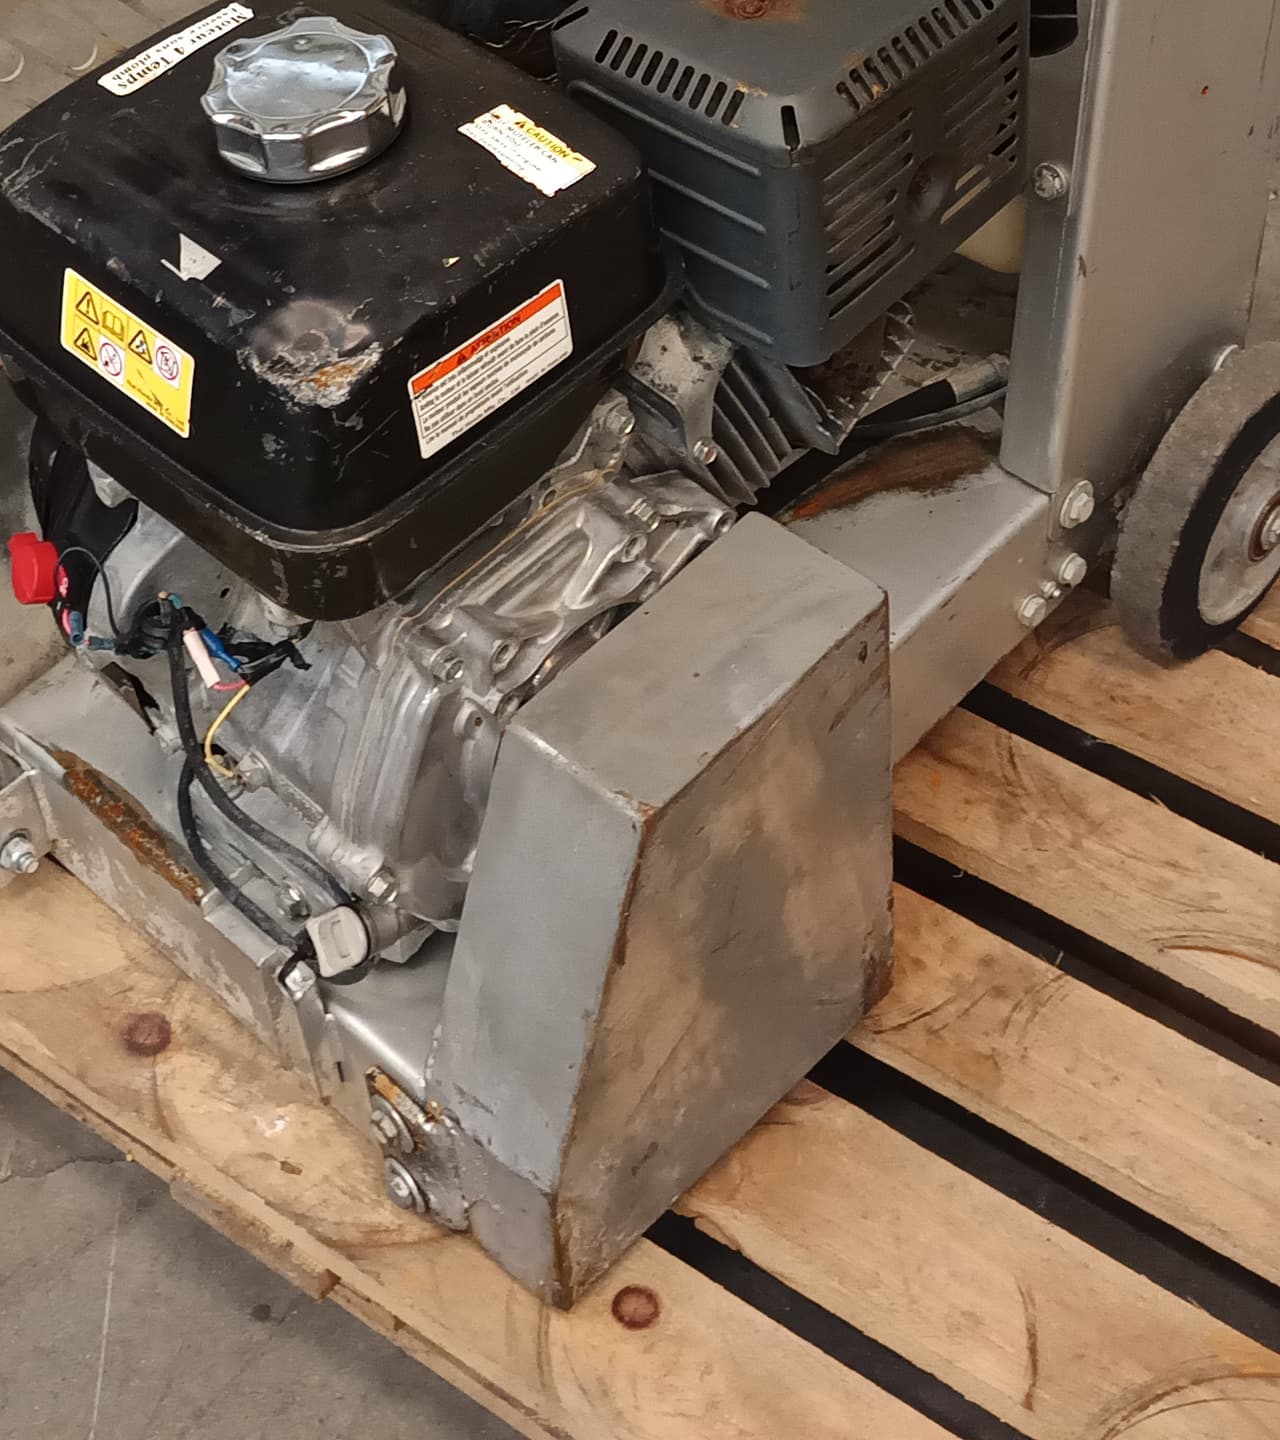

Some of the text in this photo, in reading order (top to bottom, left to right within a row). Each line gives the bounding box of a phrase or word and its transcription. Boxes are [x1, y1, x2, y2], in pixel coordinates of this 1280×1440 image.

[117, 14, 247, 89] Moteur 4 Temps
[112, 54, 152, 81] plomb
[526, 127, 570, 158] CAUTION
